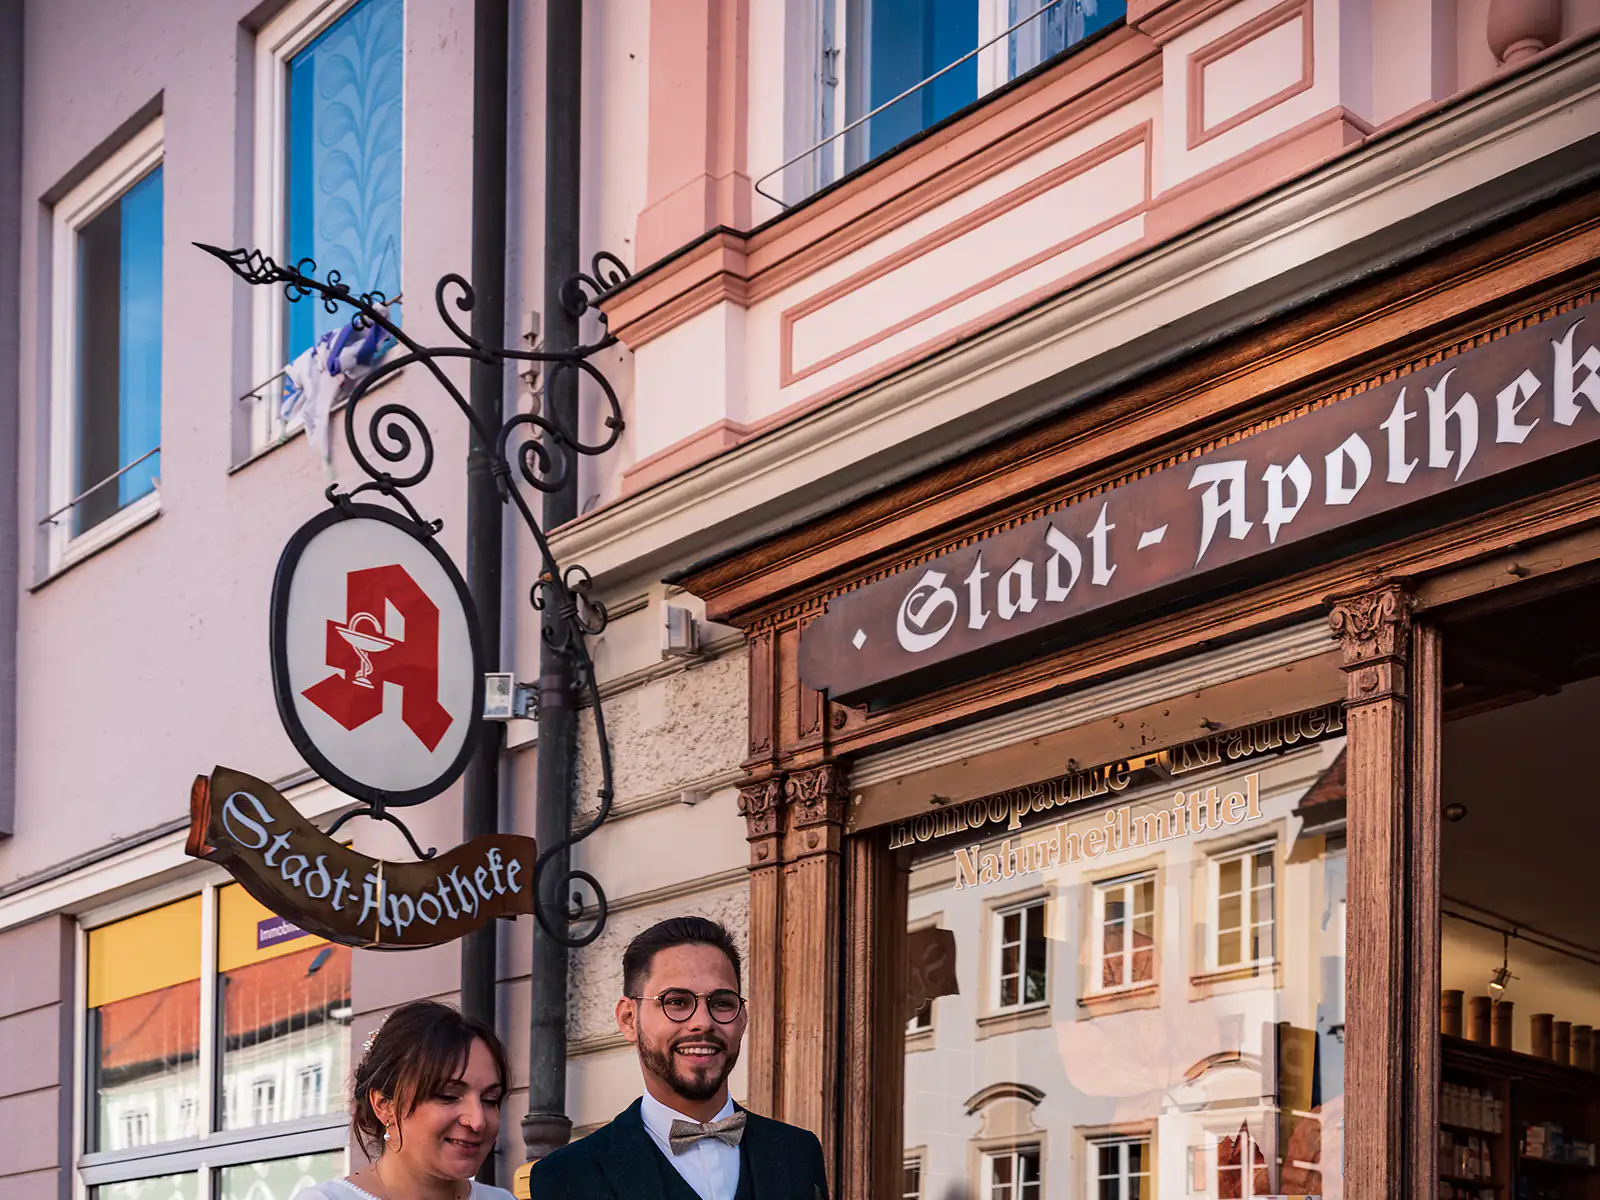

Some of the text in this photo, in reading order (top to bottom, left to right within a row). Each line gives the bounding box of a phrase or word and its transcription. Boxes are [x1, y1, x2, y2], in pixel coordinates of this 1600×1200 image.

[896, 501, 1118, 654] Stadt
[1188, 316, 1600, 569] Apothek
[953, 772, 1263, 890] Naturheilmittel
